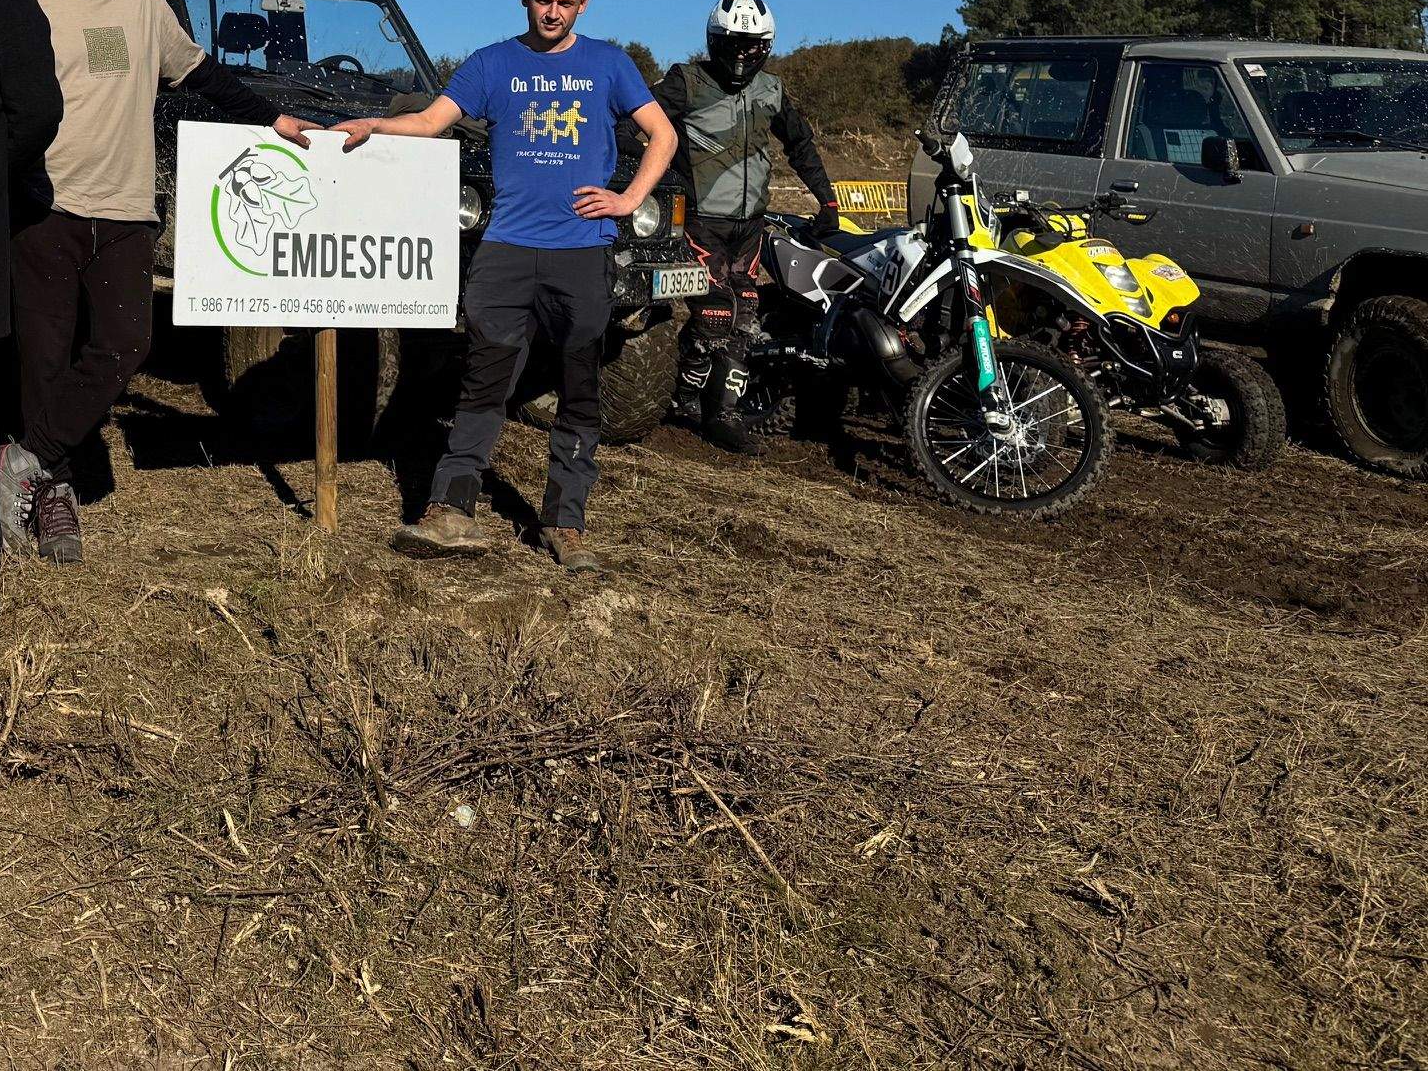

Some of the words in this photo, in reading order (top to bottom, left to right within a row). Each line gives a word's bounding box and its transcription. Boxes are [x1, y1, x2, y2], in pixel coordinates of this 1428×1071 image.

[511, 76, 528, 93] On
[532, 74, 557, 92] The
[561, 74, 594, 92] Move
[272, 232, 433, 280] EMDESFOR
[671, 271, 694, 294] 3926
[188, 297, 198, 312] T.
[201, 297, 223, 313] 986
[227, 298, 245, 313] 711
[249, 298, 270, 314] 275
[280, 299, 300, 314] 609
[303, 299, 323, 314] 456
[326, 299, 346, 314] 806
[354, 300, 448, 316] www.emdesfor.com
